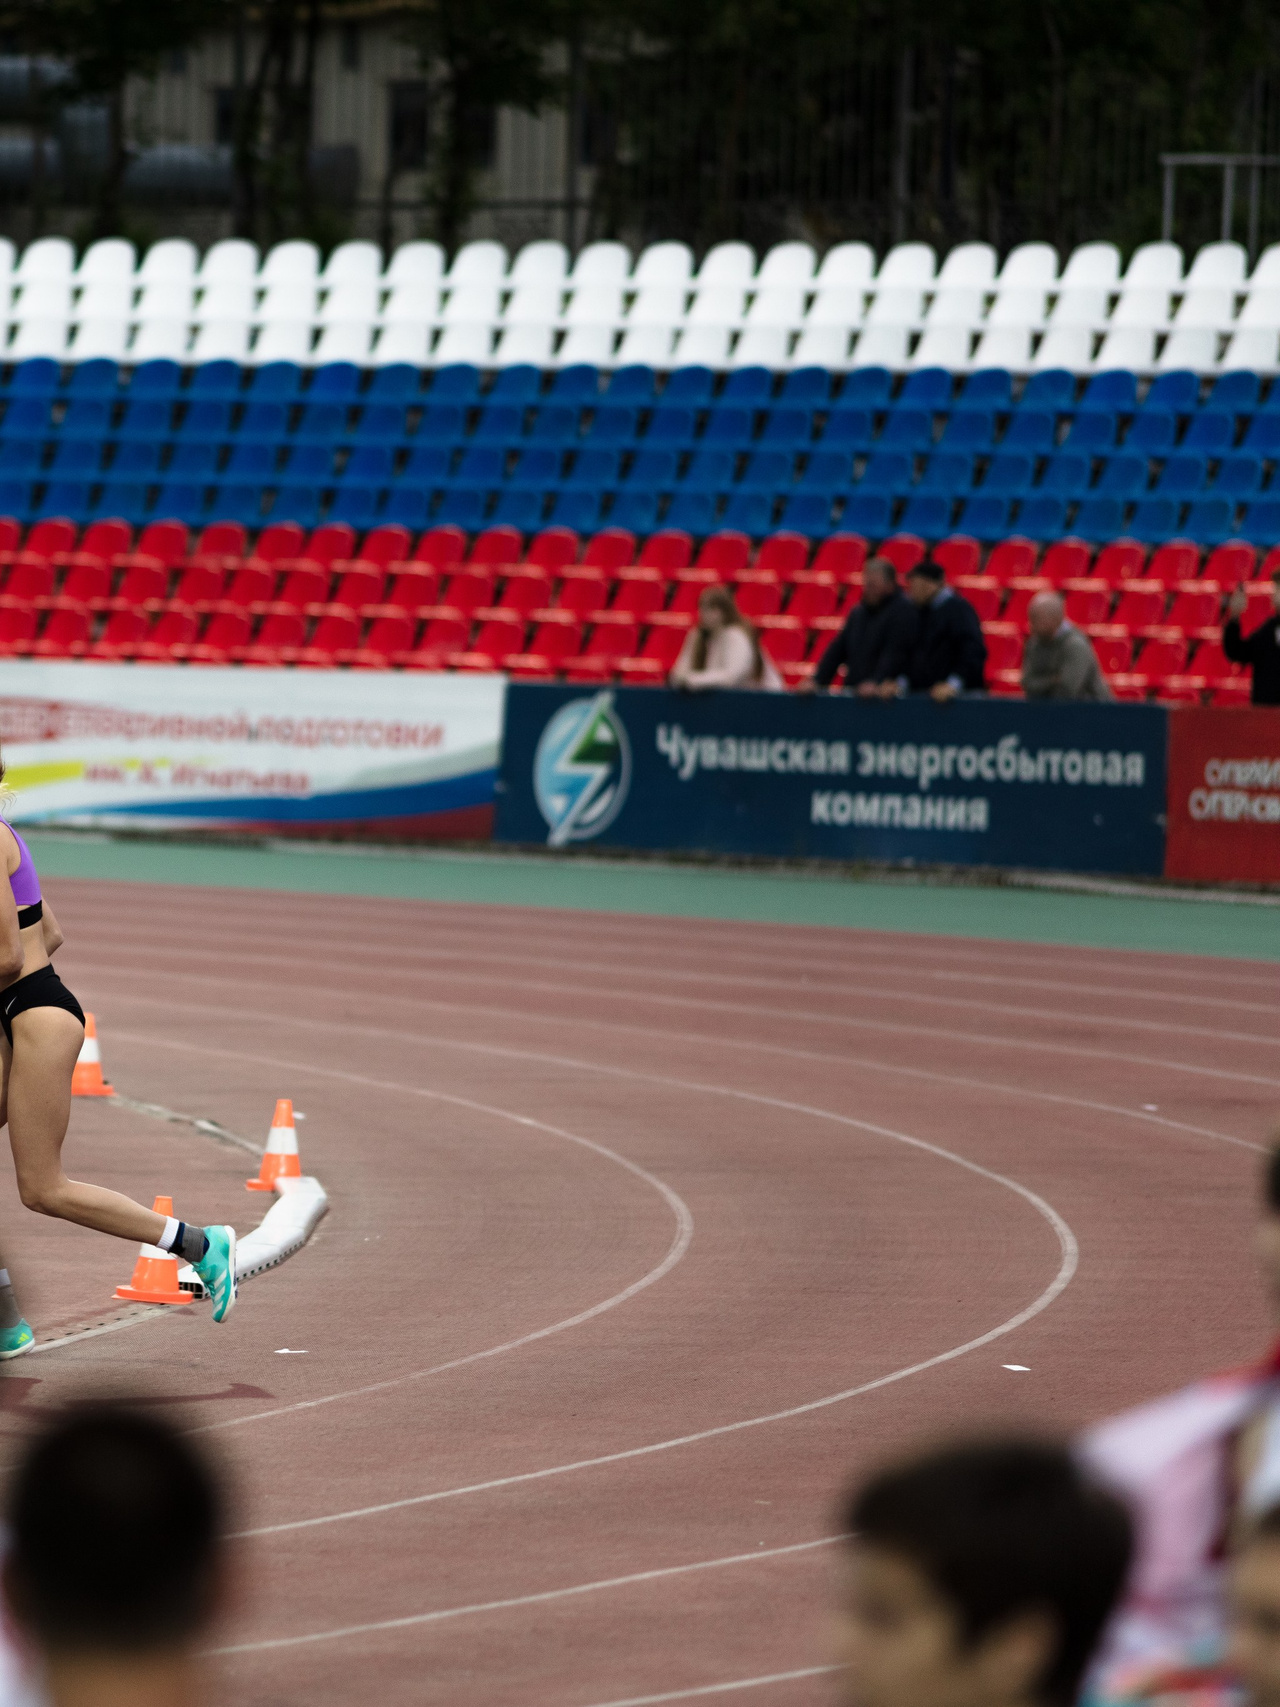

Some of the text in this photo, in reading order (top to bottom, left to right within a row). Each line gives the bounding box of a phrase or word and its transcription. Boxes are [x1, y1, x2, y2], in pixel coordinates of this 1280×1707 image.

[656, 722, 850, 781] Чувашская
[857, 733, 1144, 790] энергосбытовая
[810, 790, 988, 832] компания
